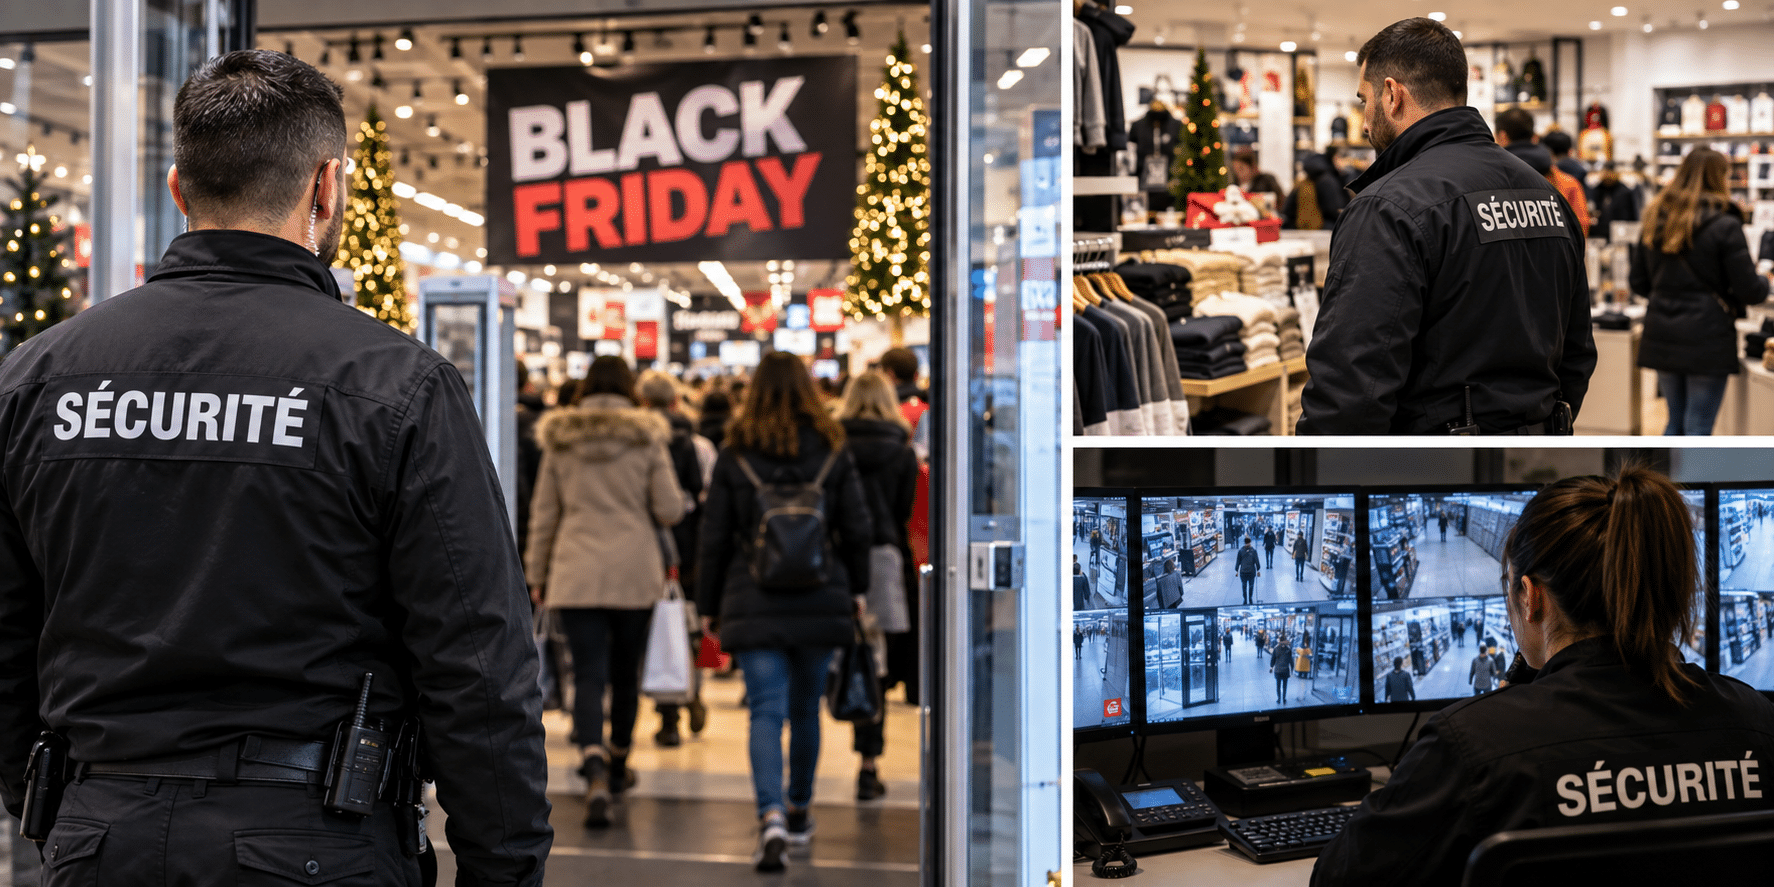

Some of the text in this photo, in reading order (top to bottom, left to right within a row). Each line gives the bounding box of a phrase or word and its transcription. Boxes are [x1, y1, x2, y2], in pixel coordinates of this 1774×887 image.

[508, 75, 807, 182] BLACK
[513, 151, 823, 258] FRIDAY
[1477, 195, 1565, 232] SÉCURITÉ
[53, 380, 309, 448] SÉCURITÉ
[1556, 750, 1763, 817] SÉCURITÉ
